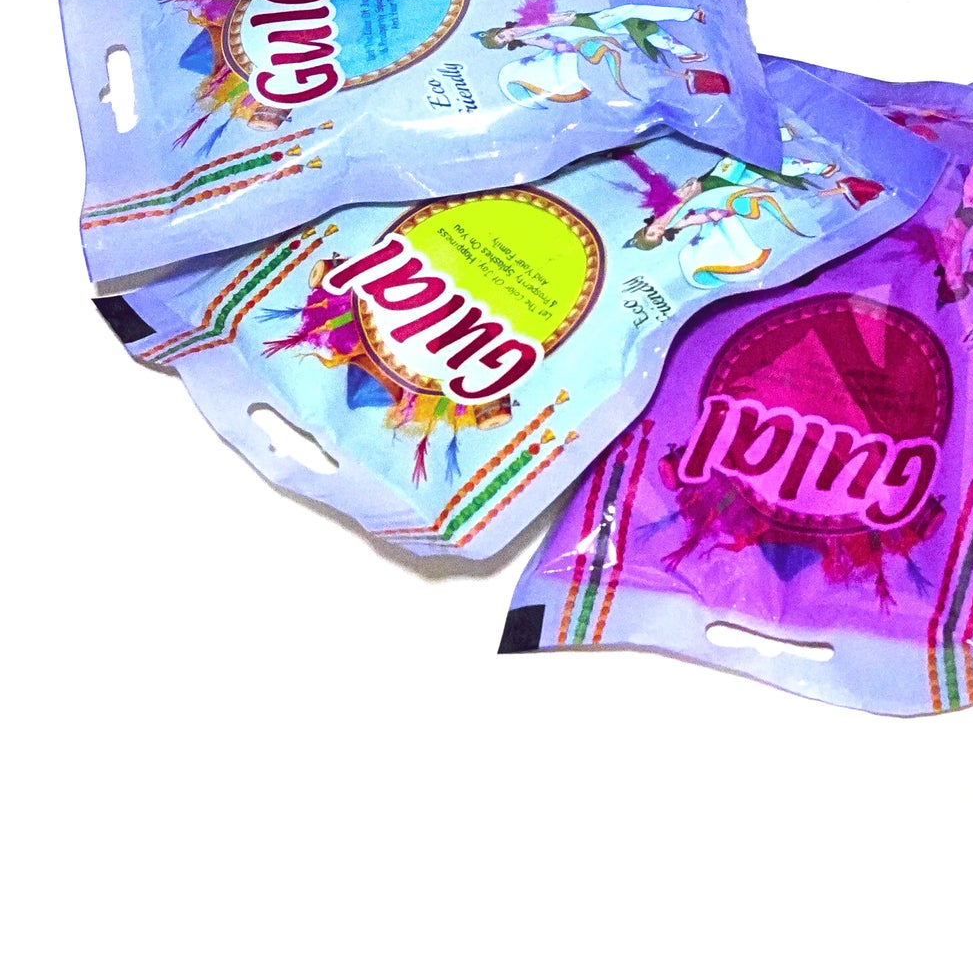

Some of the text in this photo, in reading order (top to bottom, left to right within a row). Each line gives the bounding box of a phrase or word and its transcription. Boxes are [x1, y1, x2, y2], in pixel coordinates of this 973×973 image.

[427, 78, 452, 110] Eco
[437, 63, 479, 114] riendly
[454, 223, 468, 239] You
[438, 227, 476, 265] Happiness
[470, 237, 482, 249] On
[480, 247, 516, 277] Splashes
[514, 259, 532, 276] Your
[492, 277, 504, 285] Of
[516, 275, 550, 305] Prosperity
[532, 273, 548, 285] And
[504, 285, 524, 299] Color
[524, 299, 536, 313] The
[538, 309, 552, 321] Let
[623, 299, 649, 330] Eco
[329, 239, 537, 400] Gulal
[684, 399, 938, 525] Gulal
